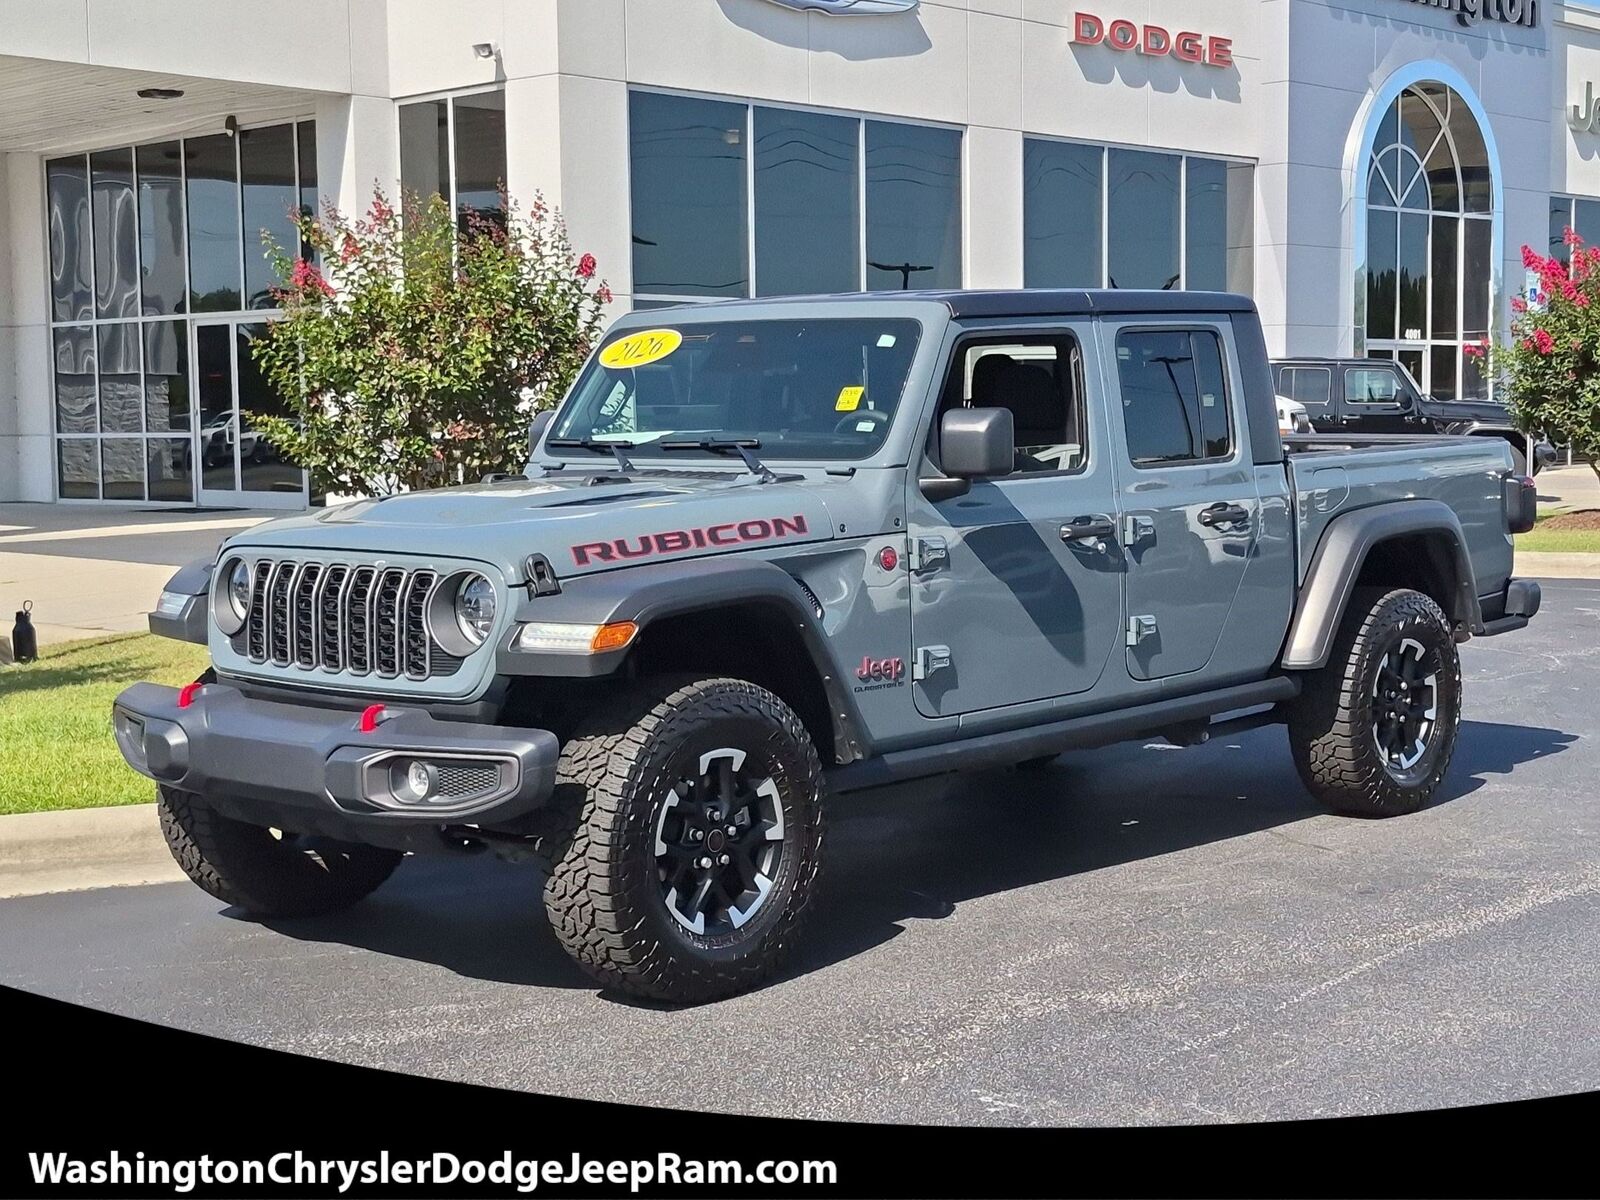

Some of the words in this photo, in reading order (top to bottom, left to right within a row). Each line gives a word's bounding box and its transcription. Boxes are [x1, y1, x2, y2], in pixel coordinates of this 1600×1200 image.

[1074, 12, 1233, 67] DODGE
[1404, 328, 1421, 340] 4001
[610, 335, 670, 363] 2026
[570, 514, 809, 567] RUBICON
[854, 656, 903, 682] Jeep
